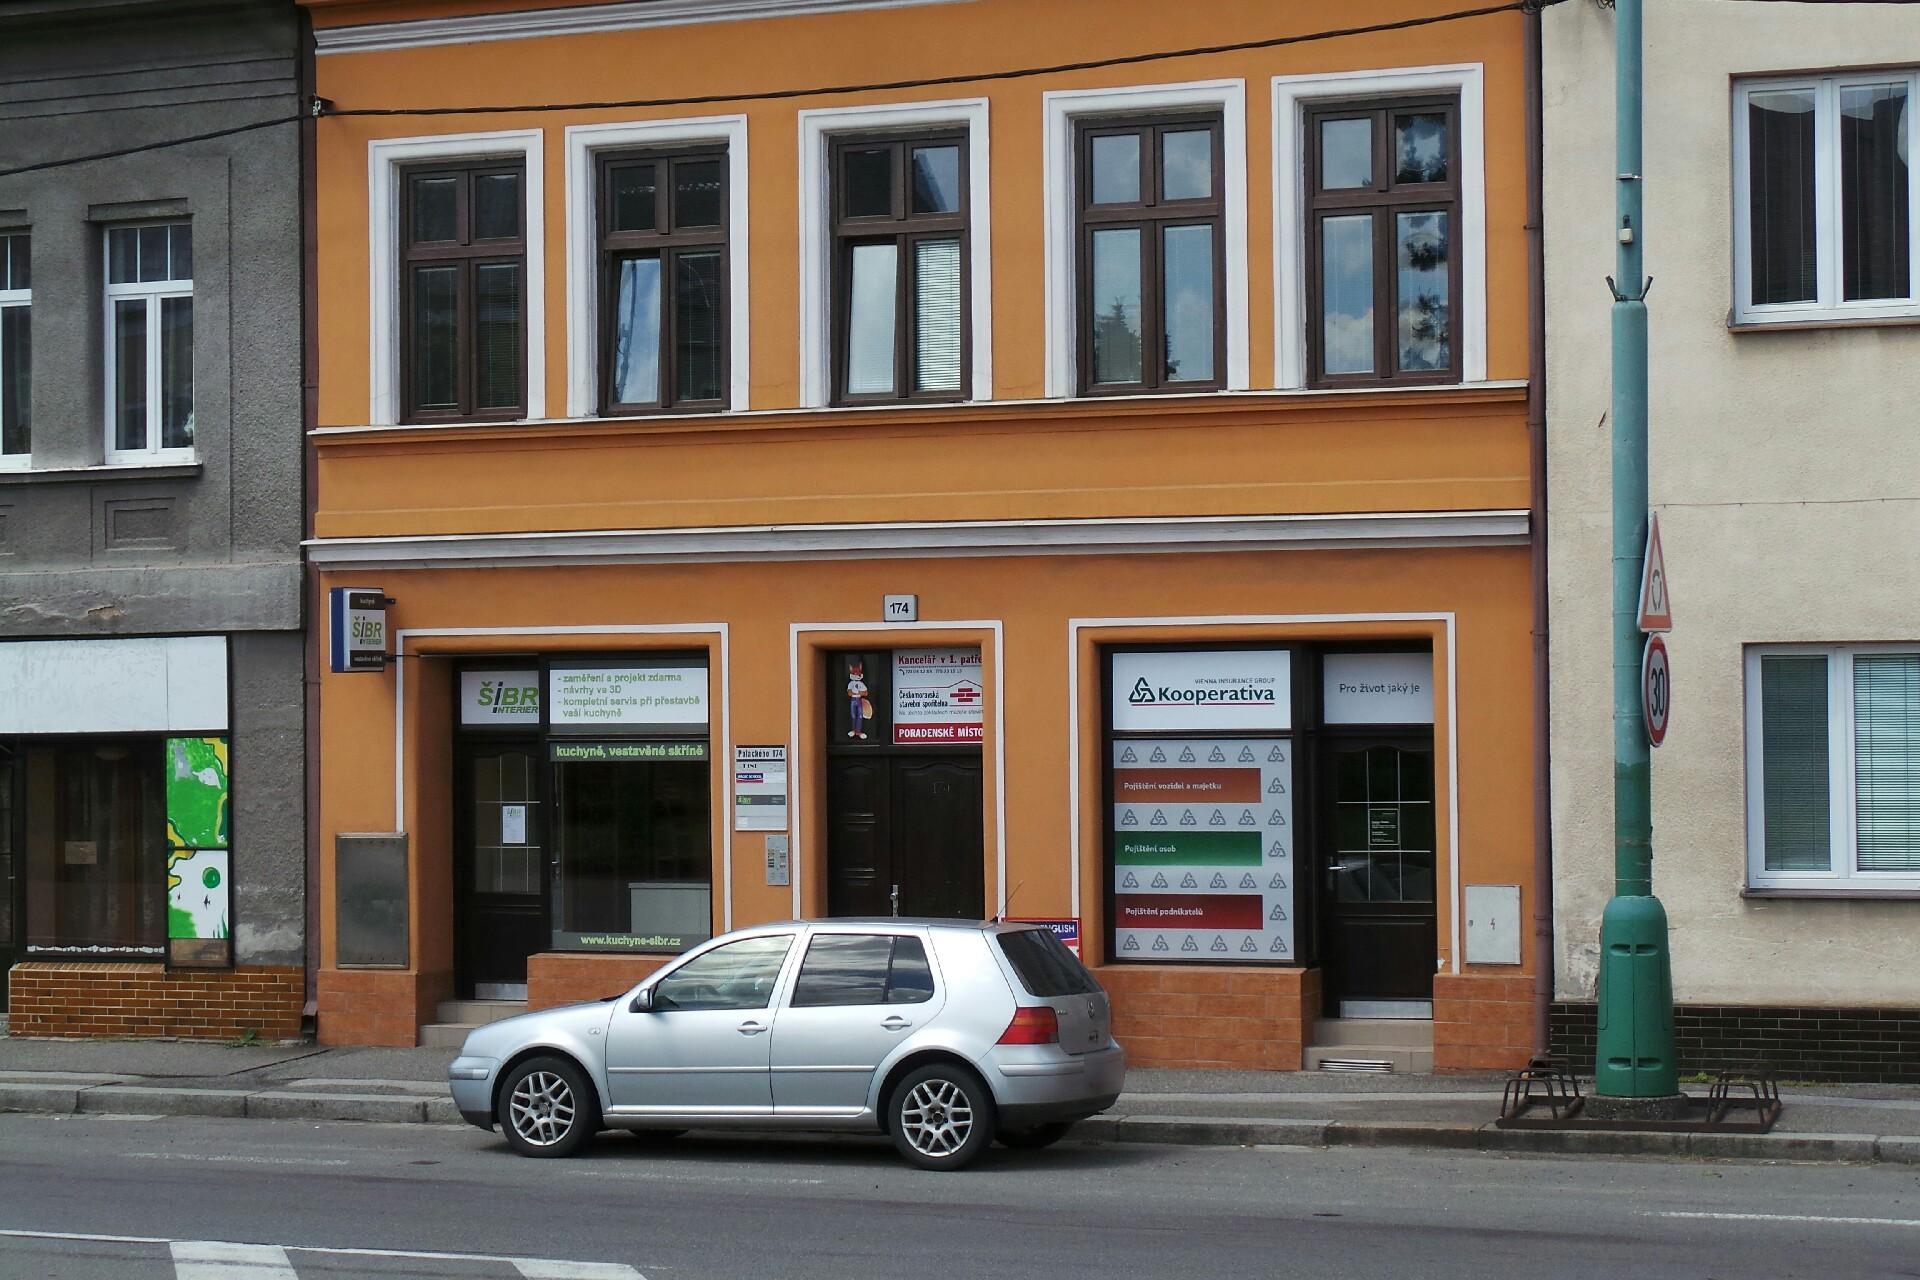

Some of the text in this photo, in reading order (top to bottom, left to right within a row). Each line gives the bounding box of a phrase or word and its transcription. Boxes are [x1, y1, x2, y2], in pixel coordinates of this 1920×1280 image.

[890, 602, 908, 614] 174
[898, 655, 936, 664] Kancelář
[950, 655, 956, 663] 1.
[563, 674, 604, 682] zaměření
[614, 674, 646, 684] projekt
[648, 673, 682, 682] zdarma
[563, 686, 593, 695] návrhy
[610, 685, 622, 694] 3D
[1340, 683, 1420, 694] Pro život jaký je
[1651, 667, 1665, 716] 30
[1158, 685, 1275, 705] Kooperativa
[563, 697, 607, 706] kompletní
[640, 696, 652, 706] při
[655, 696, 700, 706] přestavbě
[584, 708, 622, 718] kuchyně
[899, 726, 983, 738] PORADENSKÉ MÍSTO
[609, 746, 665, 756] vestavěné
[668, 744, 703, 756] skříně
[772, 749, 783, 758] 174
[1125, 845, 1157, 853] Pojištění
[1126, 908, 1203, 916] Pojištění podnikatelů
[580, 935, 680, 946] www.kuchyne-sibr.cz
